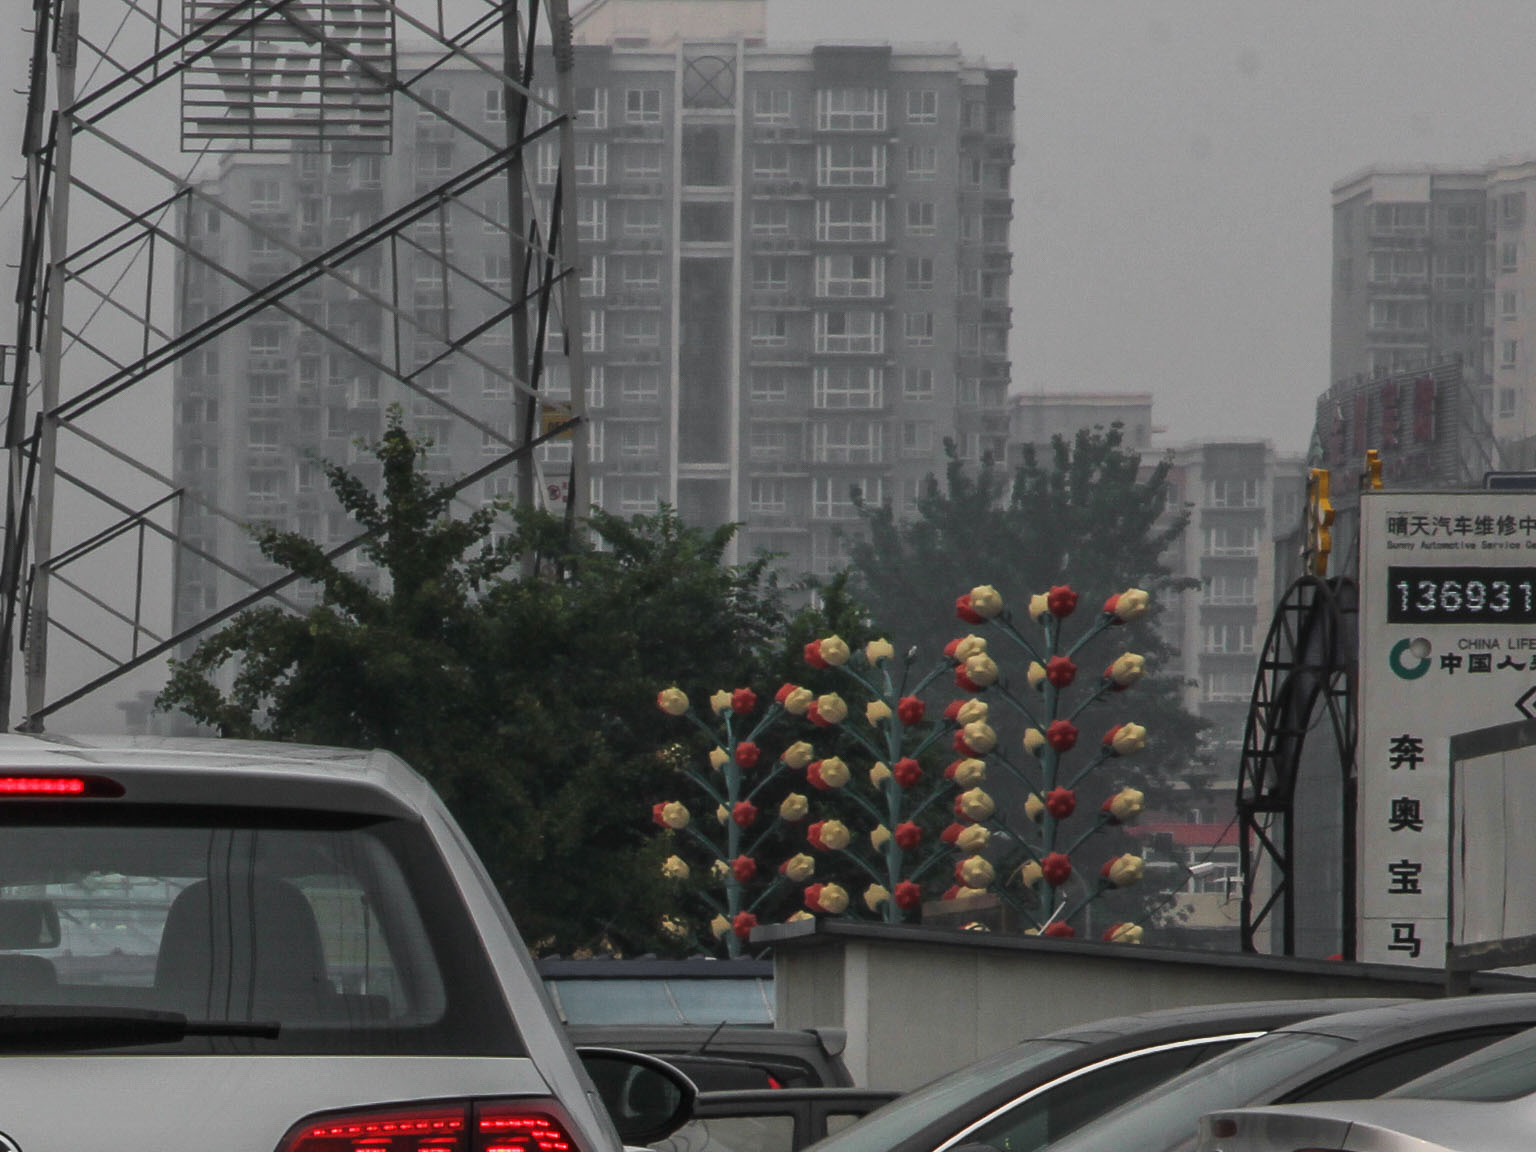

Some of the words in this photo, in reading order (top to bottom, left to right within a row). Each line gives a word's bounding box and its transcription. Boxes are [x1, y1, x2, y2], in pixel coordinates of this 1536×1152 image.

[1387, 515, 1536, 536] 晴天汽车维修中
[1421, 541, 1476, 550] Automotive
[1396, 580, 1533, 613] 136931
[1458, 638, 1501, 650] CHINA
[1440, 652, 1536, 675] 中国人
